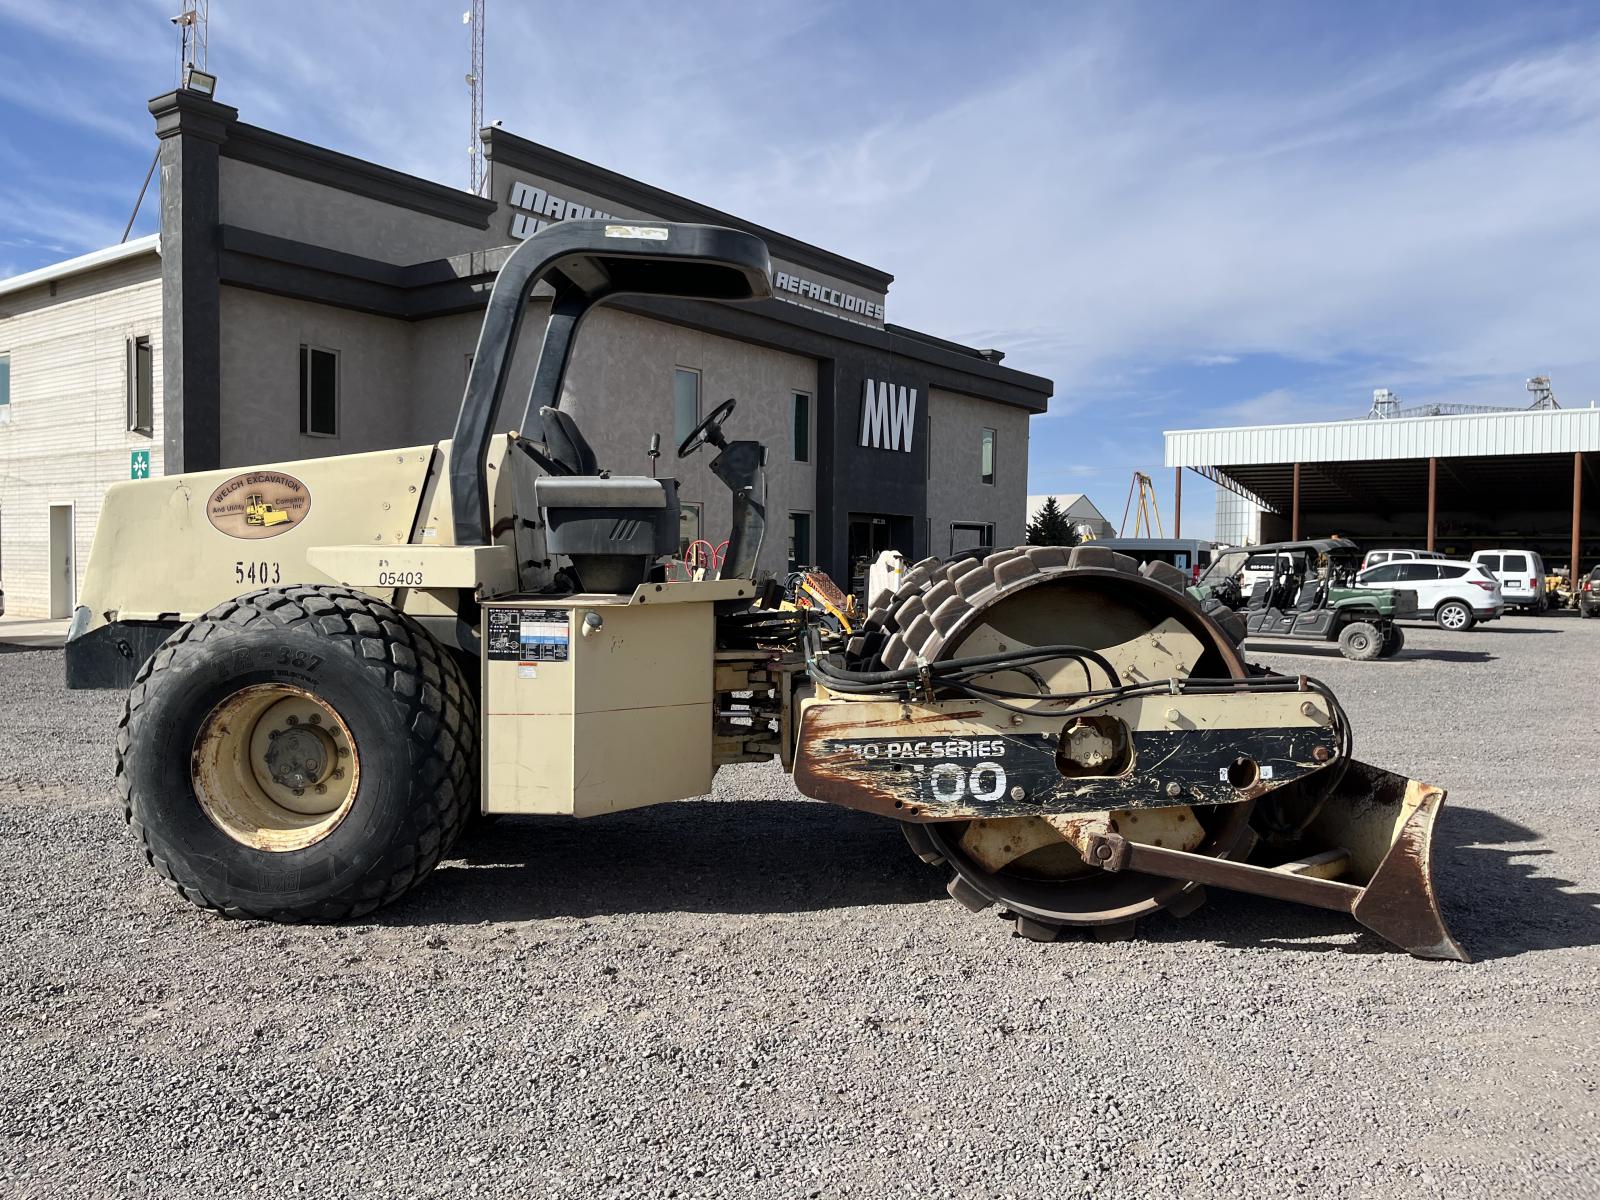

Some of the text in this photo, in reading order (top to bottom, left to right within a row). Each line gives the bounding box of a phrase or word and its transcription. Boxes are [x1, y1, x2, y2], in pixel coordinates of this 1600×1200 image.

[775, 271, 885, 320] REFACCIONES
[861, 378, 918, 453] MW
[214, 475, 301, 503] WELCH EXCAVATION
[275, 496, 305, 505] Company
[235, 561, 281, 584] 5403
[379, 571, 423, 585] 05403
[931, 740, 1005, 758] SERIES
